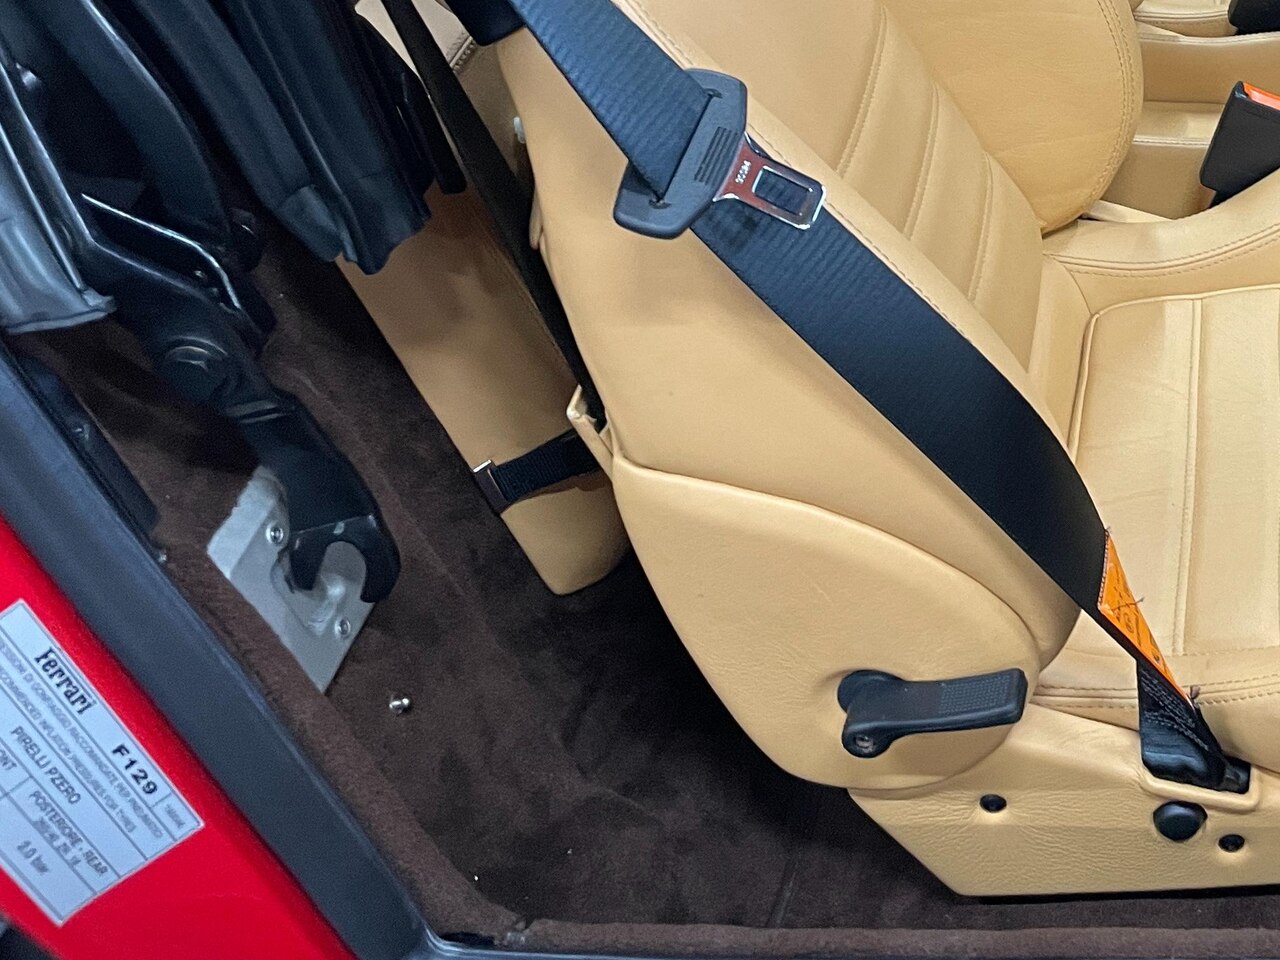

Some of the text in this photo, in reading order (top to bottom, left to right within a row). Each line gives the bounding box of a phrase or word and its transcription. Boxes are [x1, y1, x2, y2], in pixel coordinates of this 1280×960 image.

[34, 646, 97, 715] Ferrari
[11, 725, 51, 769] PIRELLI
[45, 766, 82, 805] PZERO
[112, 744, 158, 795] F129
[29, 790, 84, 847] POSTERIORE
[82, 848, 109, 876] REAR
